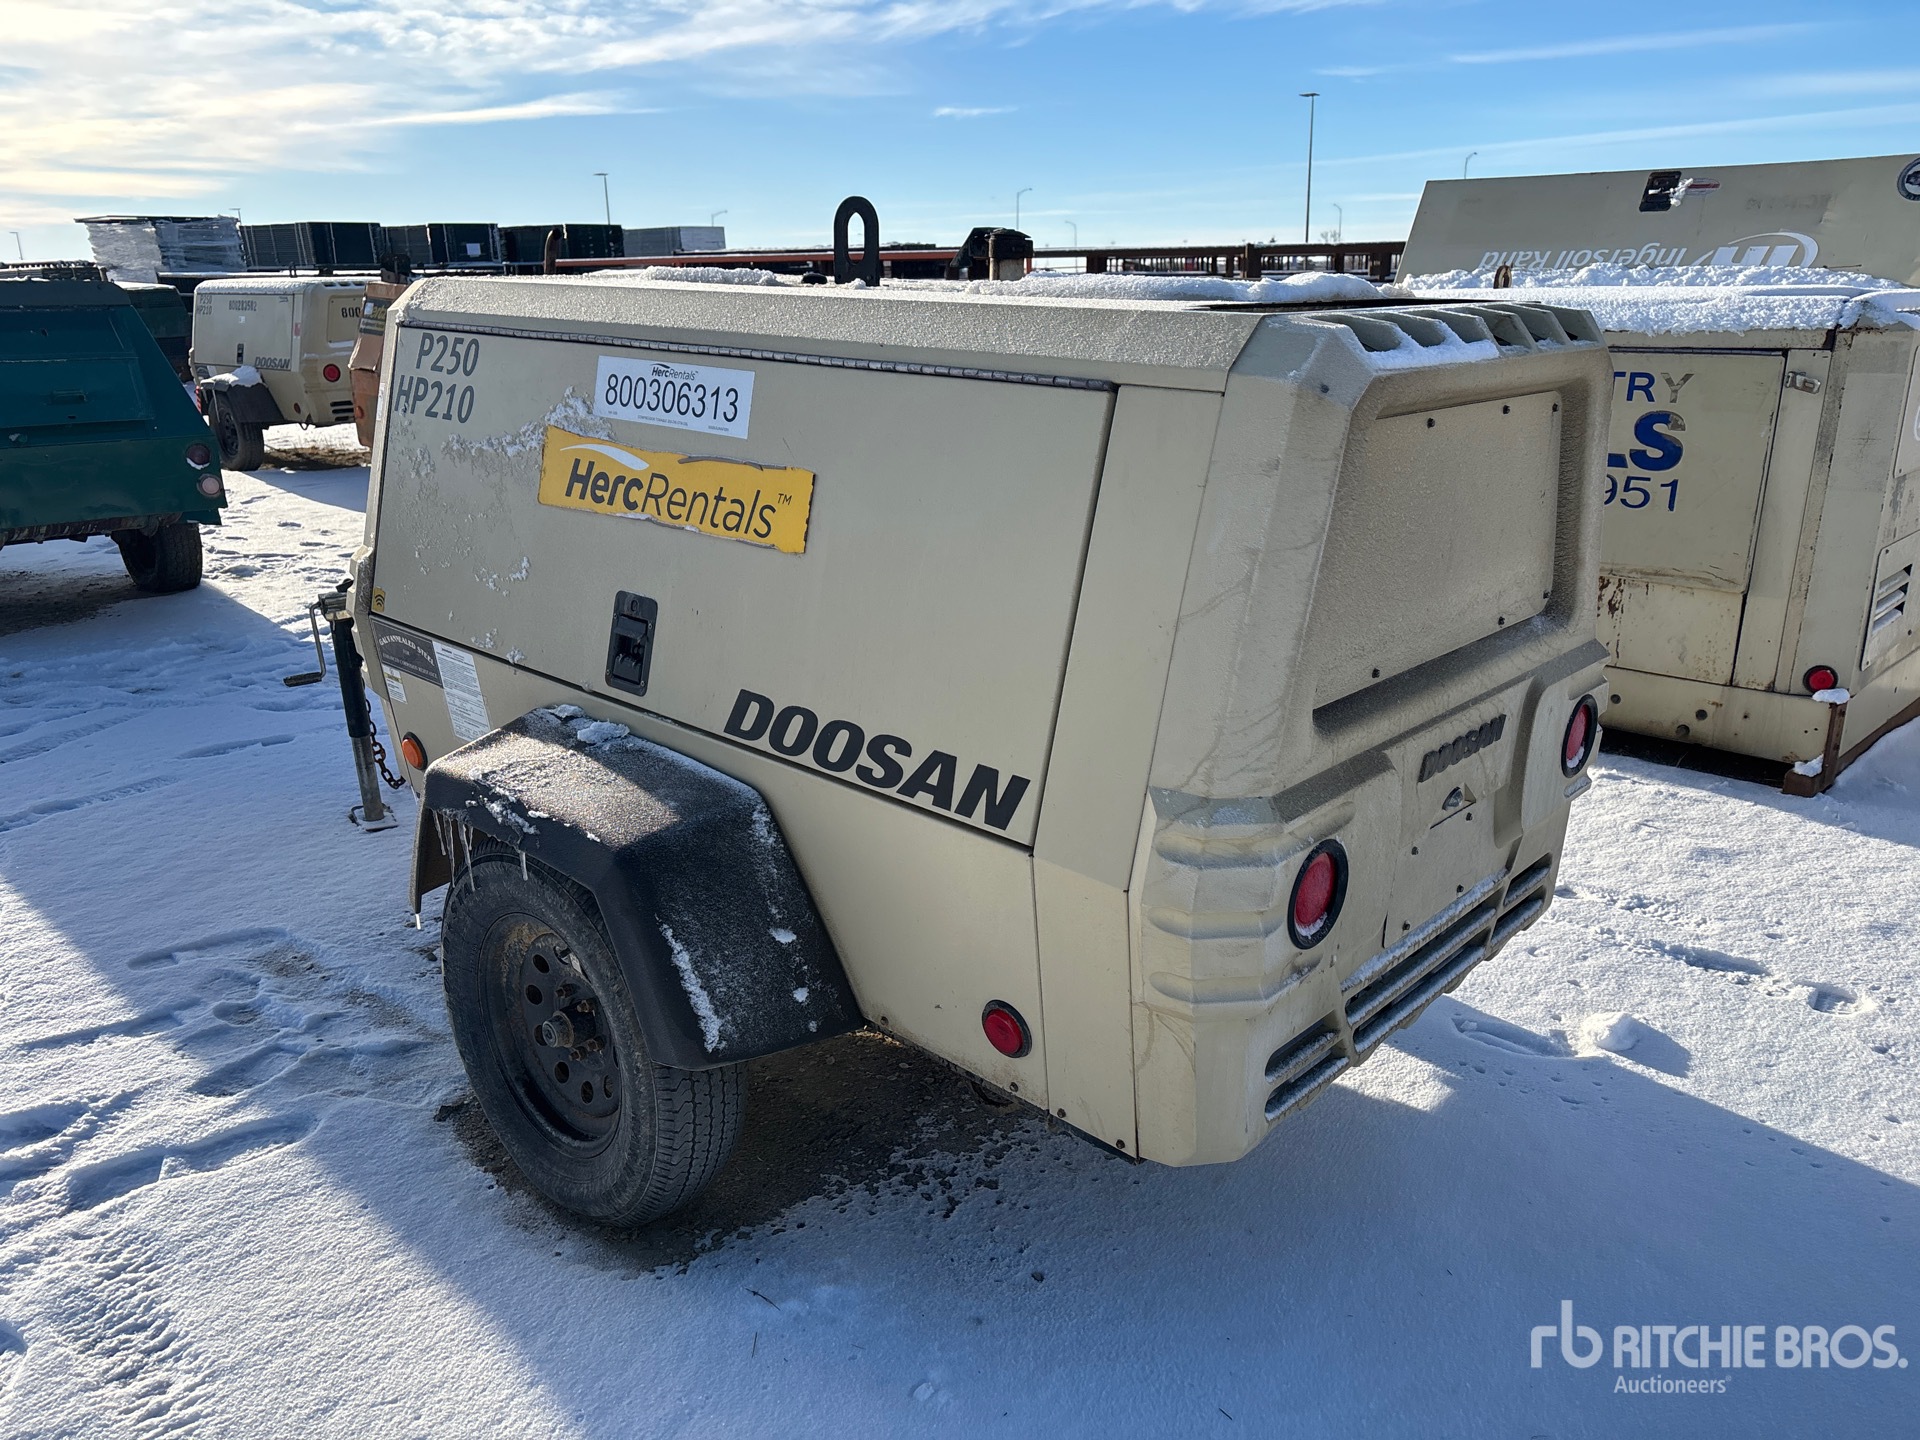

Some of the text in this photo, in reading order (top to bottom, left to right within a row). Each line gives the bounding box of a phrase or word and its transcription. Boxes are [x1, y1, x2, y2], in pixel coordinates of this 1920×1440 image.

[254, 356, 291, 369] DOOSAN
[416, 332, 480, 376] P250
[394, 374, 475, 424] HP210
[605, 373, 739, 423] 800306313
[723, 688, 1031, 831] DOOSAN
[1417, 713, 1507, 783] DOOSAN
